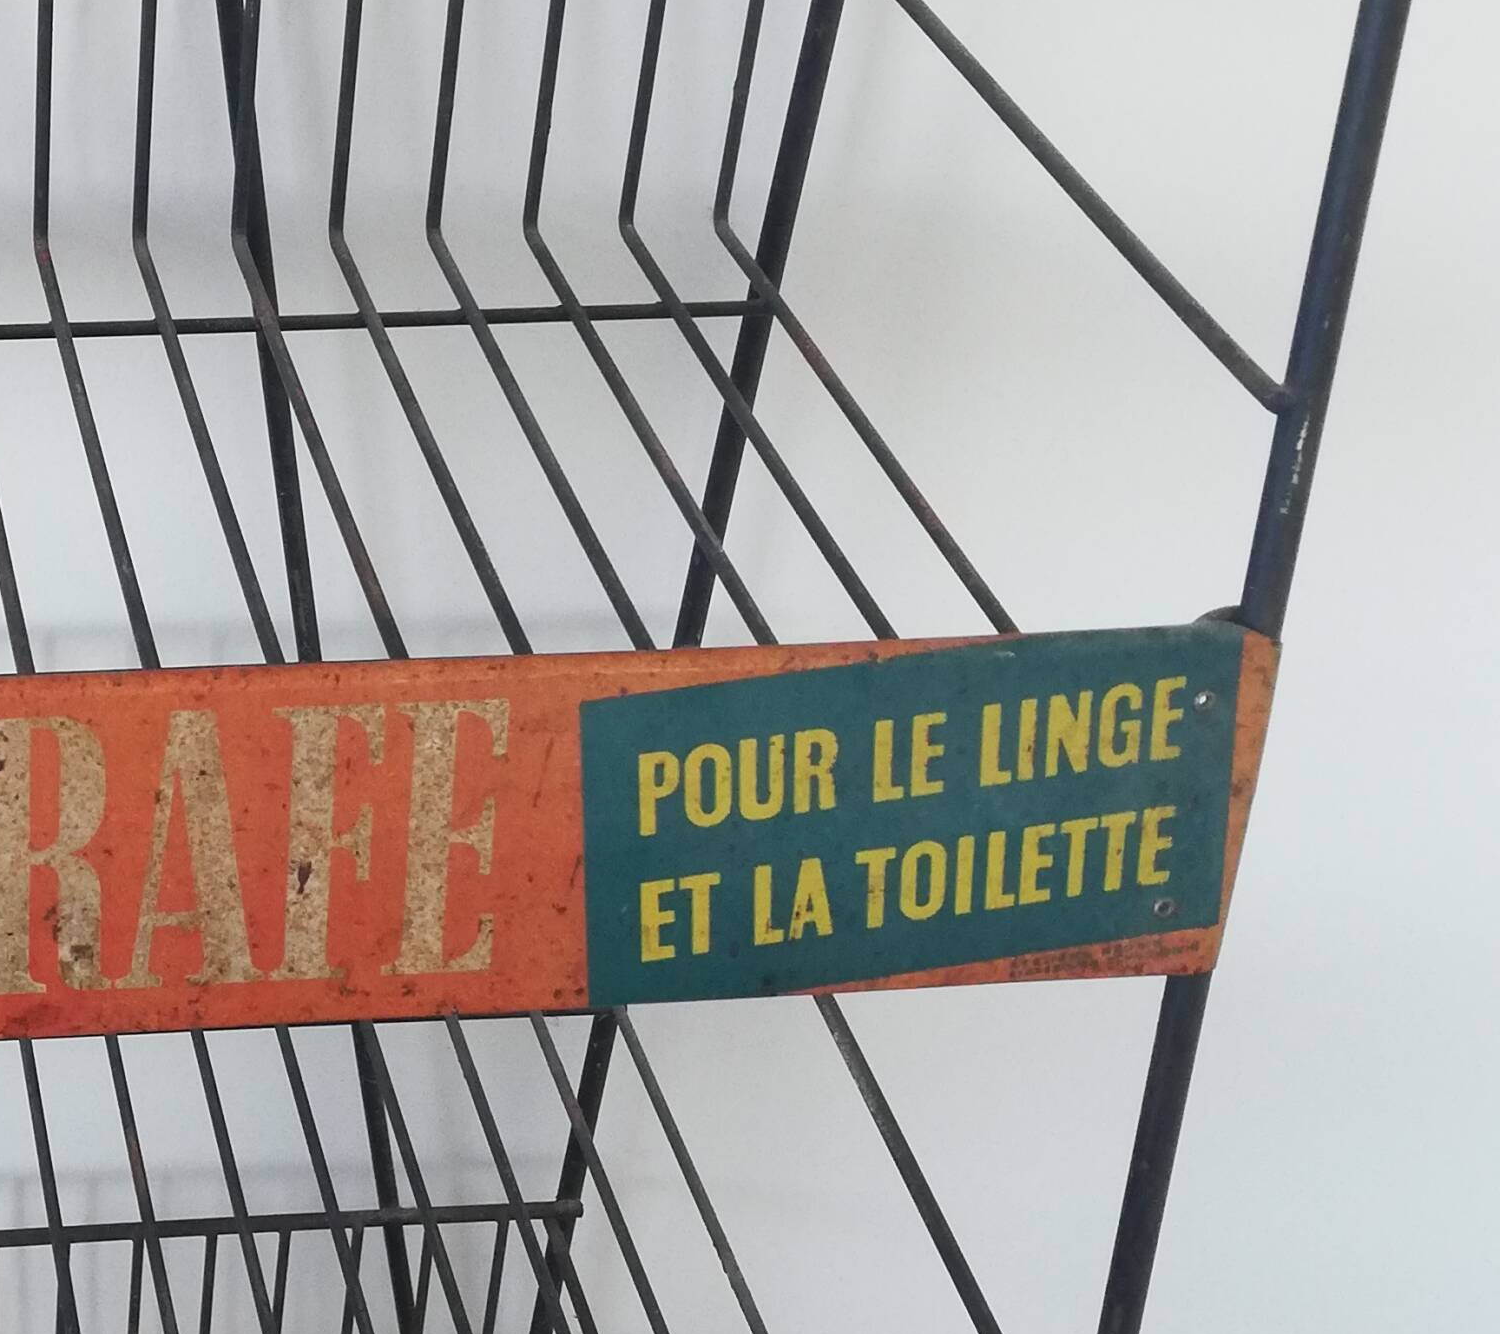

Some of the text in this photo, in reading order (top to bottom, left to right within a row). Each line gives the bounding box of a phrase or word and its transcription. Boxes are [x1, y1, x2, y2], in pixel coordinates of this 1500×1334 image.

[638, 675, 1188, 837] POUR LE LINGE
[640, 805, 1178, 962] ET LA TOILETTE
